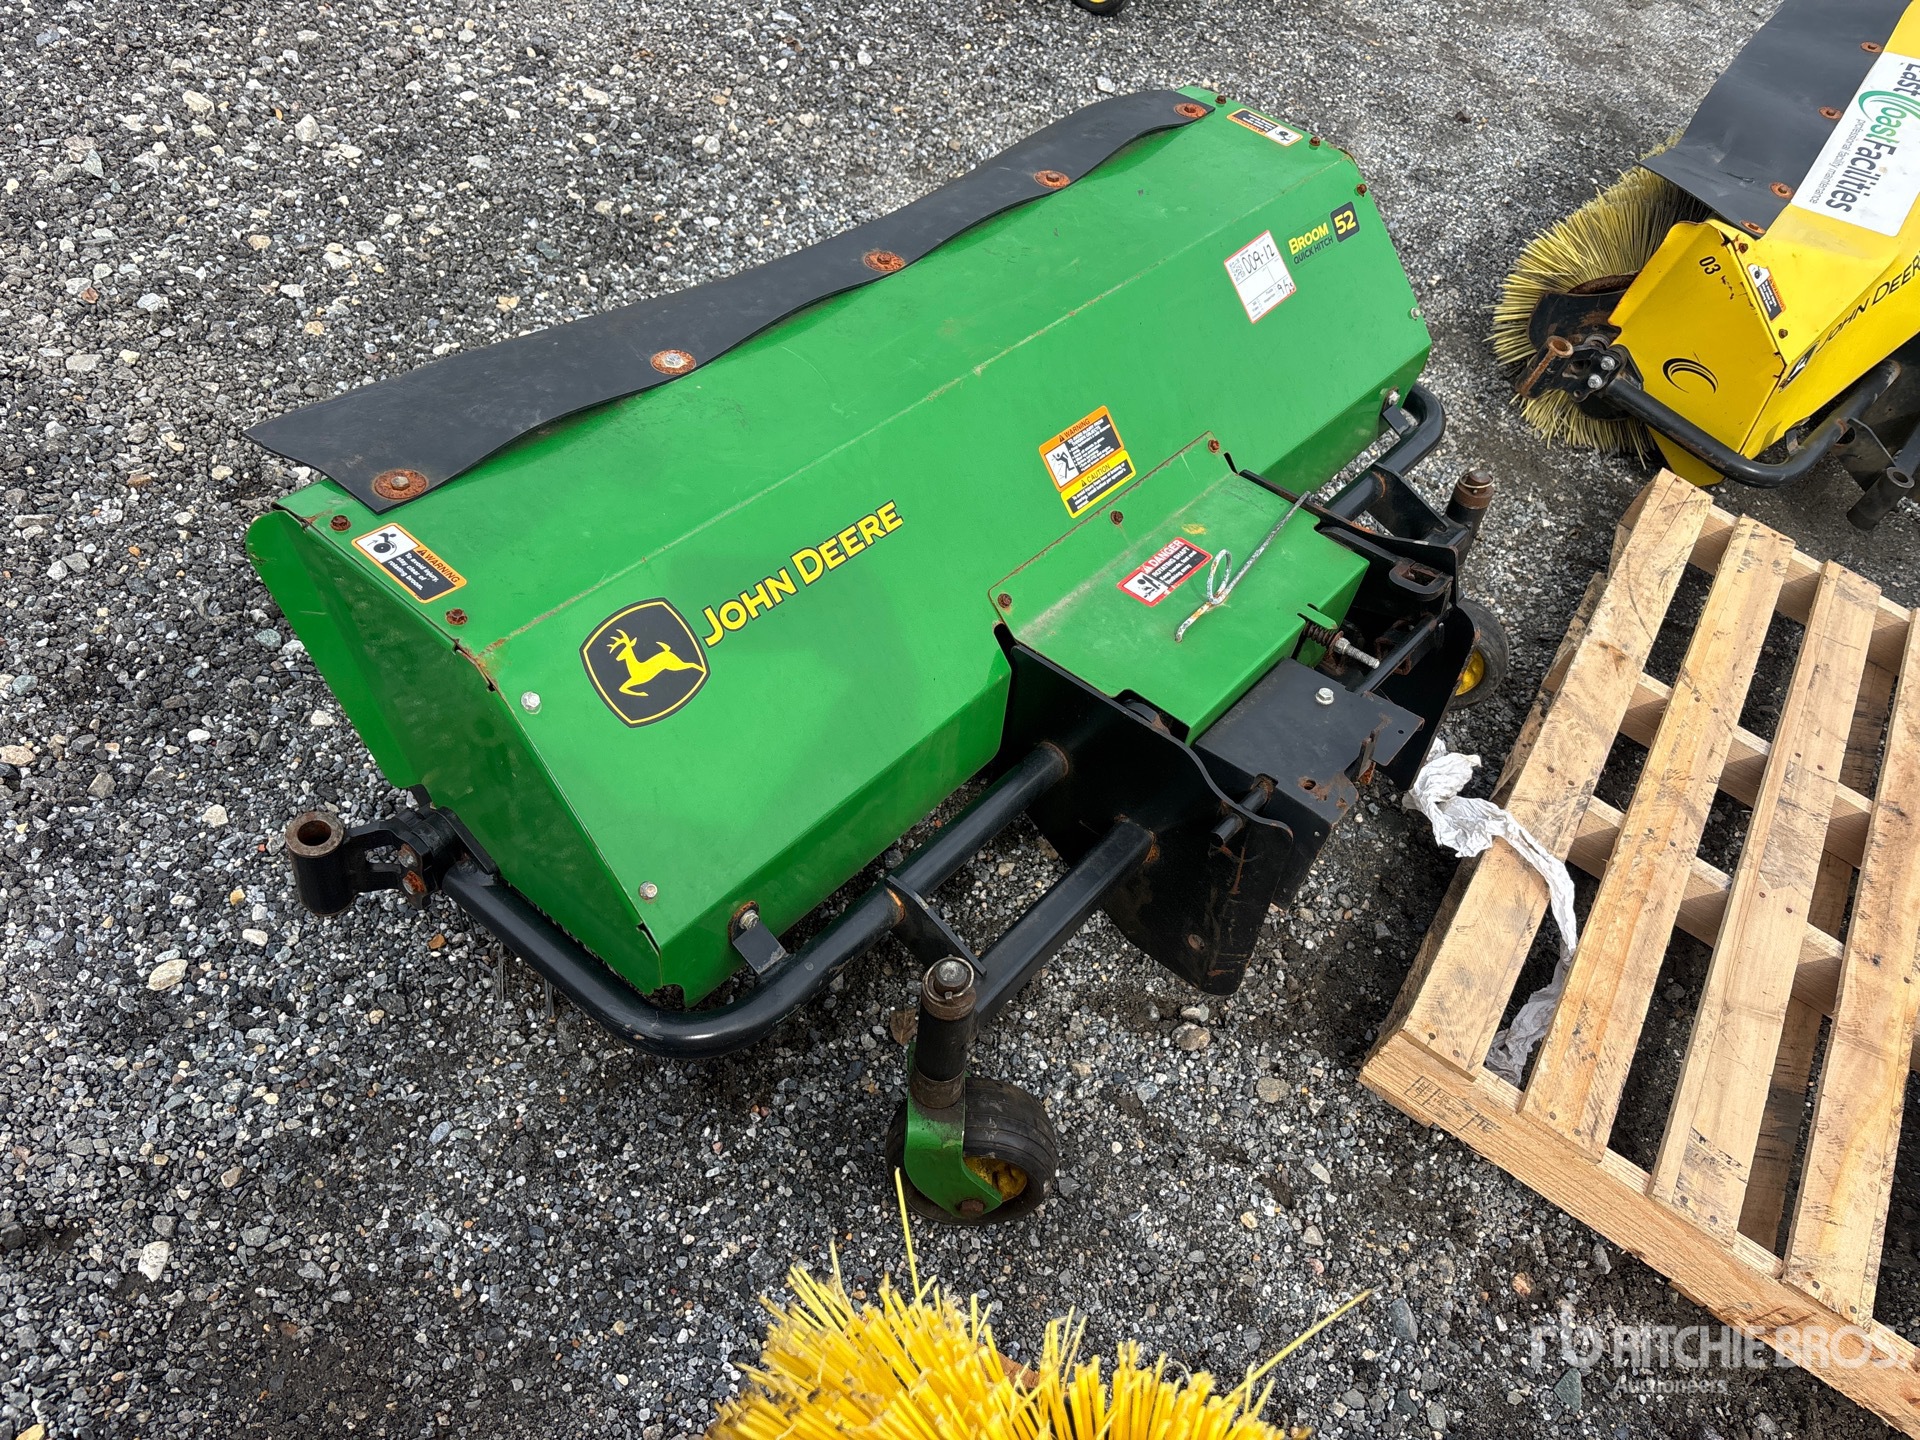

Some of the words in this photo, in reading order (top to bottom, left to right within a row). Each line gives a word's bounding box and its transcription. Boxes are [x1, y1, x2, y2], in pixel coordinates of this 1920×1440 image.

[1842, 118, 1866, 151] professional
[1826, 138, 1897, 212] Facilities
[1829, 150, 1851, 171] facility
[1809, 168, 1837, 204] maintenance
[1288, 222, 1329, 255] BROOM
[1333, 210, 1357, 235] 52
[1293, 246, 1315, 265] QUICK
[1314, 235, 1334, 254] HITCH
[1816, 297, 1870, 354] JOHN
[1872, 249, 1920, 306] DEER
[1064, 417, 1090, 438] WARNING
[1086, 462, 1110, 482] CAUTION
[422, 553, 461, 582] WARNING
[1147, 539, 1184, 567] DANGER
[701, 566, 799, 648] JOHN
[790, 499, 904, 587] DEERE
